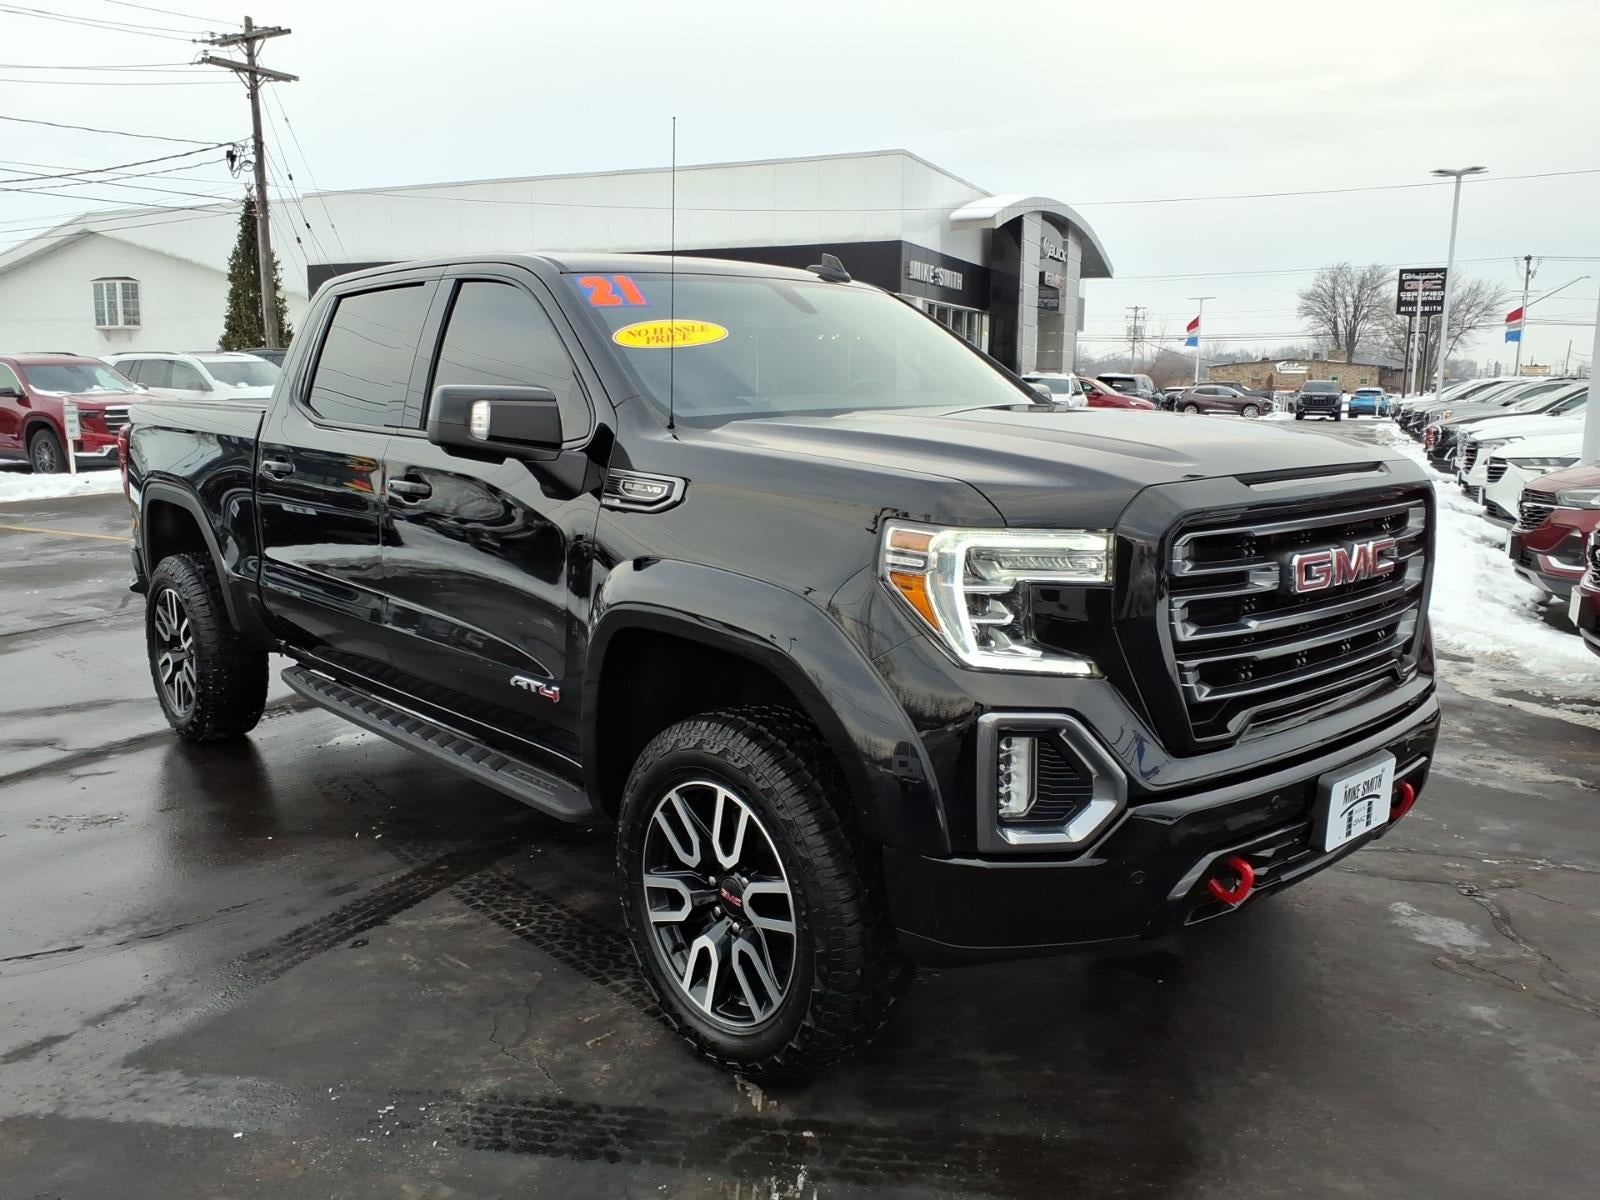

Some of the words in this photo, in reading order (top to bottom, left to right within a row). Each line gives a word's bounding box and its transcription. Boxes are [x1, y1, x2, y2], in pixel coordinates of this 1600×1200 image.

[908, 260, 935, 284] MIKE
[936, 267, 963, 291] SMITH
[1402, 272, 1445, 280] BUICK
[578, 274, 647, 306] 21
[627, 328, 649, 338] NO
[653, 324, 709, 336] HASSLE
[646, 333, 692, 345] PRICE
[647, 486, 662, 494] V8
[1292, 537, 1395, 593] GMC
[510, 675, 560, 703] AT4
[1343, 783, 1361, 806] MIKE
[1361, 774, 1384, 797] SMITH
